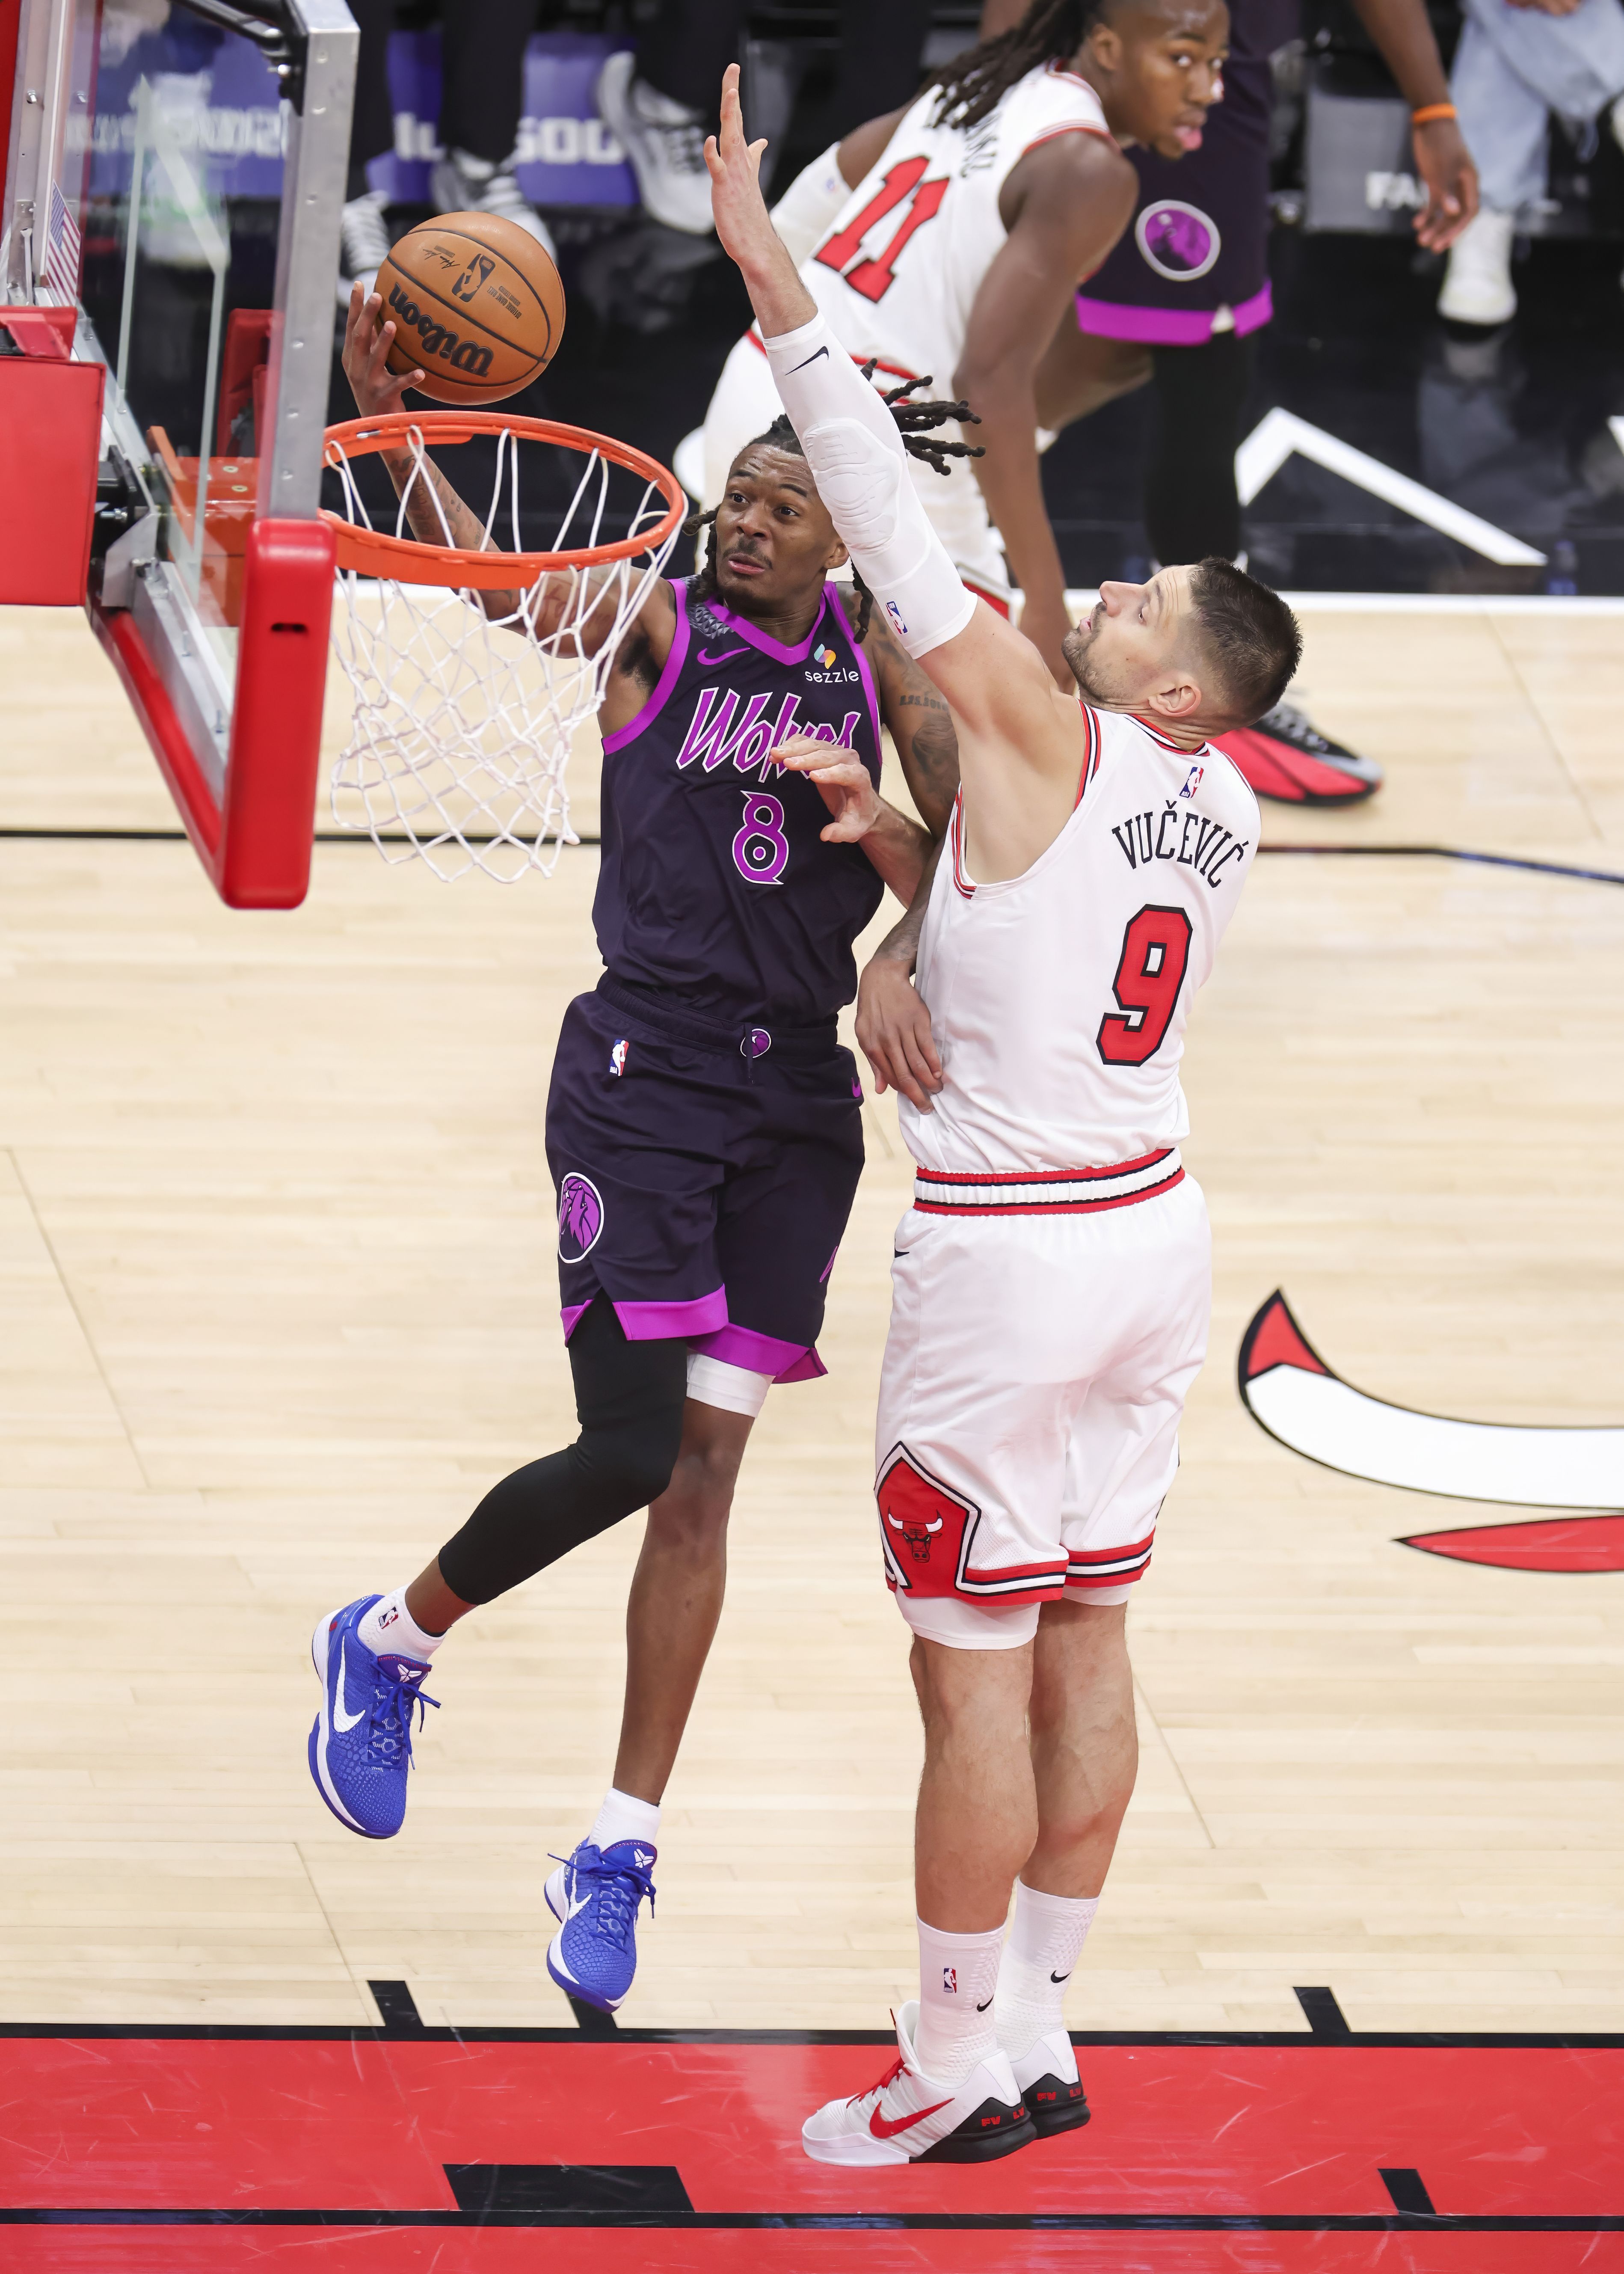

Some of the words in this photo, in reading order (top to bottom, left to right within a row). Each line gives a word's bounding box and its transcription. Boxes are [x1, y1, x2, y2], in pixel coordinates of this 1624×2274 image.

[813, 155, 949, 304] 11
[388, 282, 493, 377] Wilson
[805, 668, 859, 683] sezzle
[732, 790, 789, 885] 8
[1111, 800, 1249, 888] VUČEVIĆ
[1096, 904, 1193, 1067] 9
